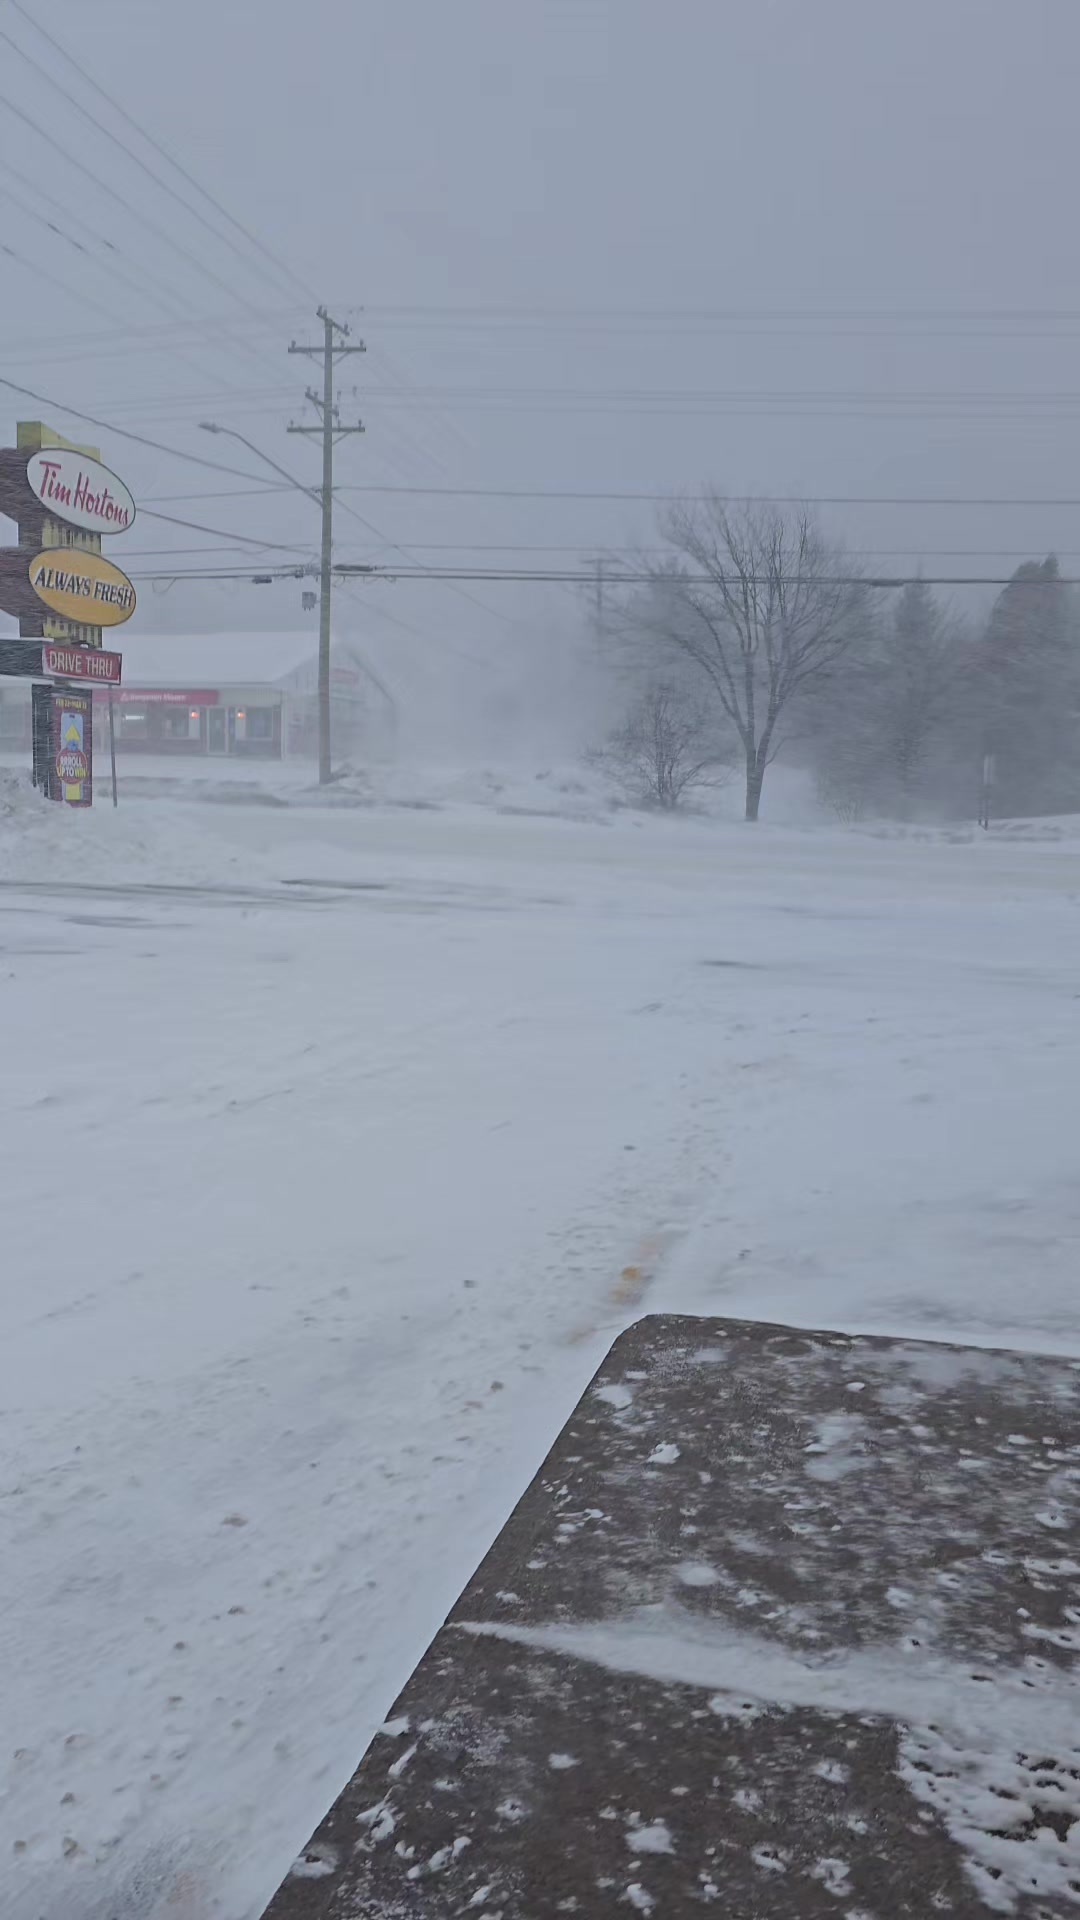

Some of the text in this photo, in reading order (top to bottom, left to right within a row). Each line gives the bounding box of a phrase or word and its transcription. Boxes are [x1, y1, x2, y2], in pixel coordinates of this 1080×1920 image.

[39, 460, 129, 526] Tim Hortons
[34, 566, 133, 607] ALWAYS FRESH
[49, 650, 112, 677] DRIVE THRU
[75, 767, 86, 778] WIN
